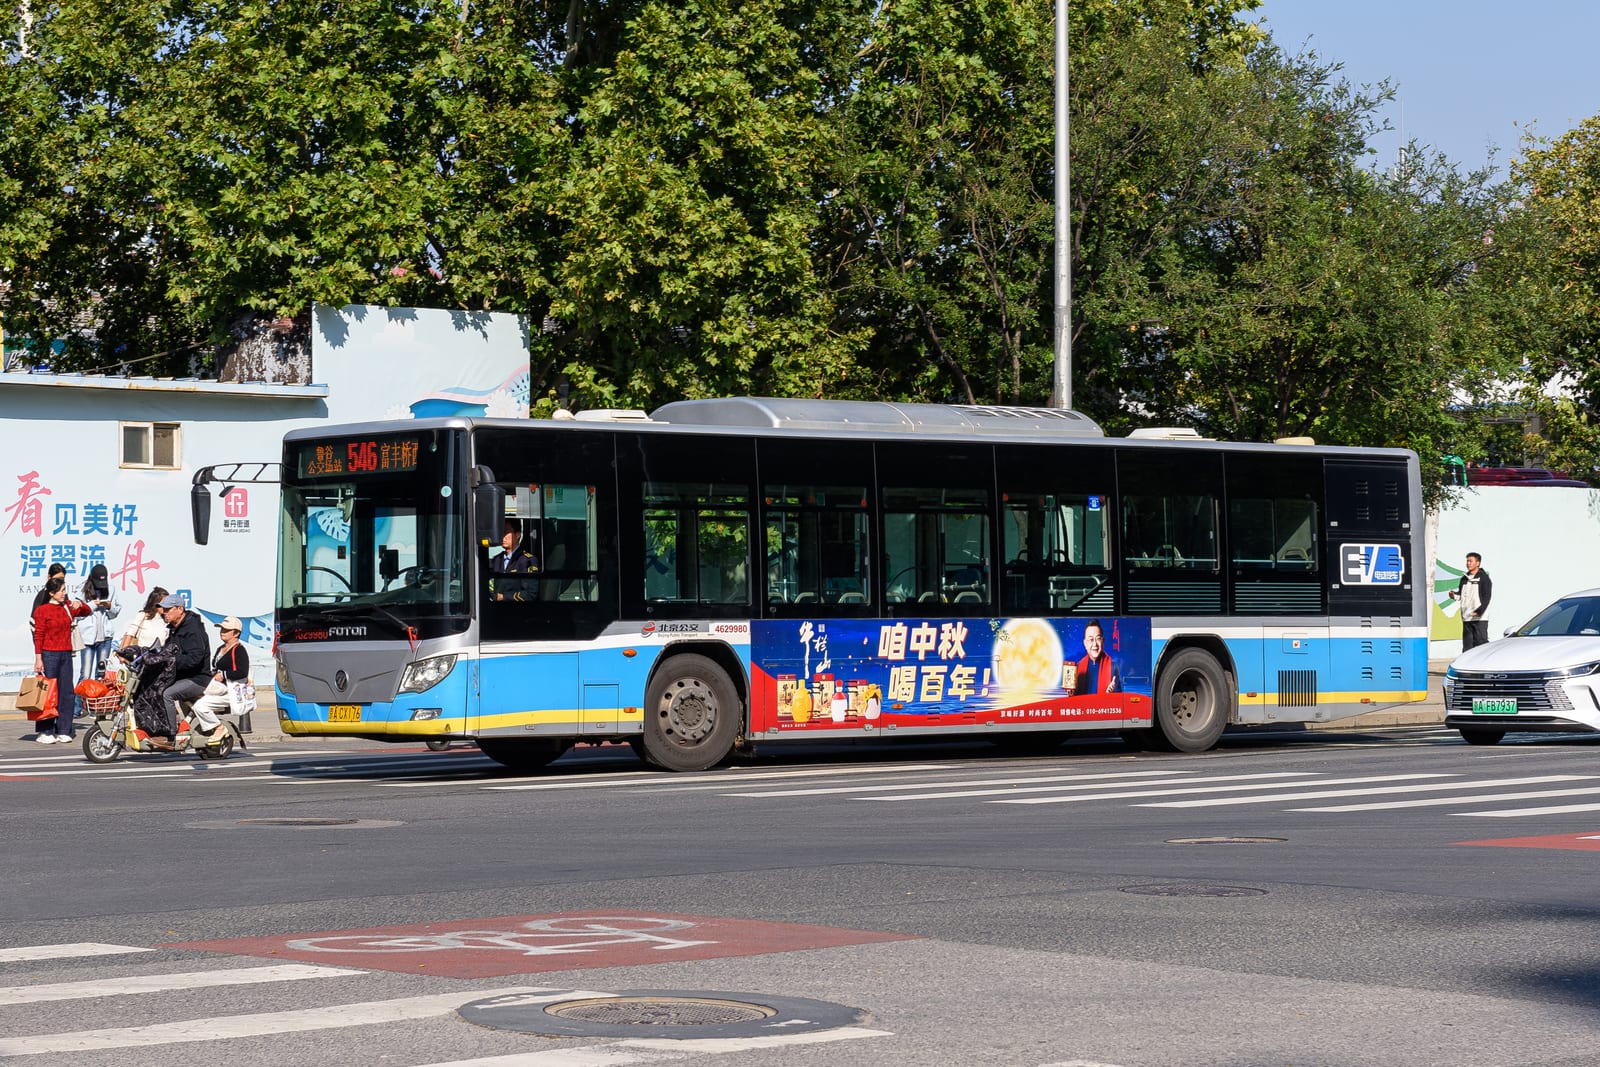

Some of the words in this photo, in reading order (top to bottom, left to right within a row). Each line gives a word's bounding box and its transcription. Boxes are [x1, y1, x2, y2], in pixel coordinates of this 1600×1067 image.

[347, 441, 378, 472] 546
[3, 470, 139, 537] 看见美好
[328, 625, 367, 637] FOTON
[659, 623, 699, 632] 北京公交
[715, 624, 748, 633] 4629980
[878, 621, 968, 661] 咱中秋
